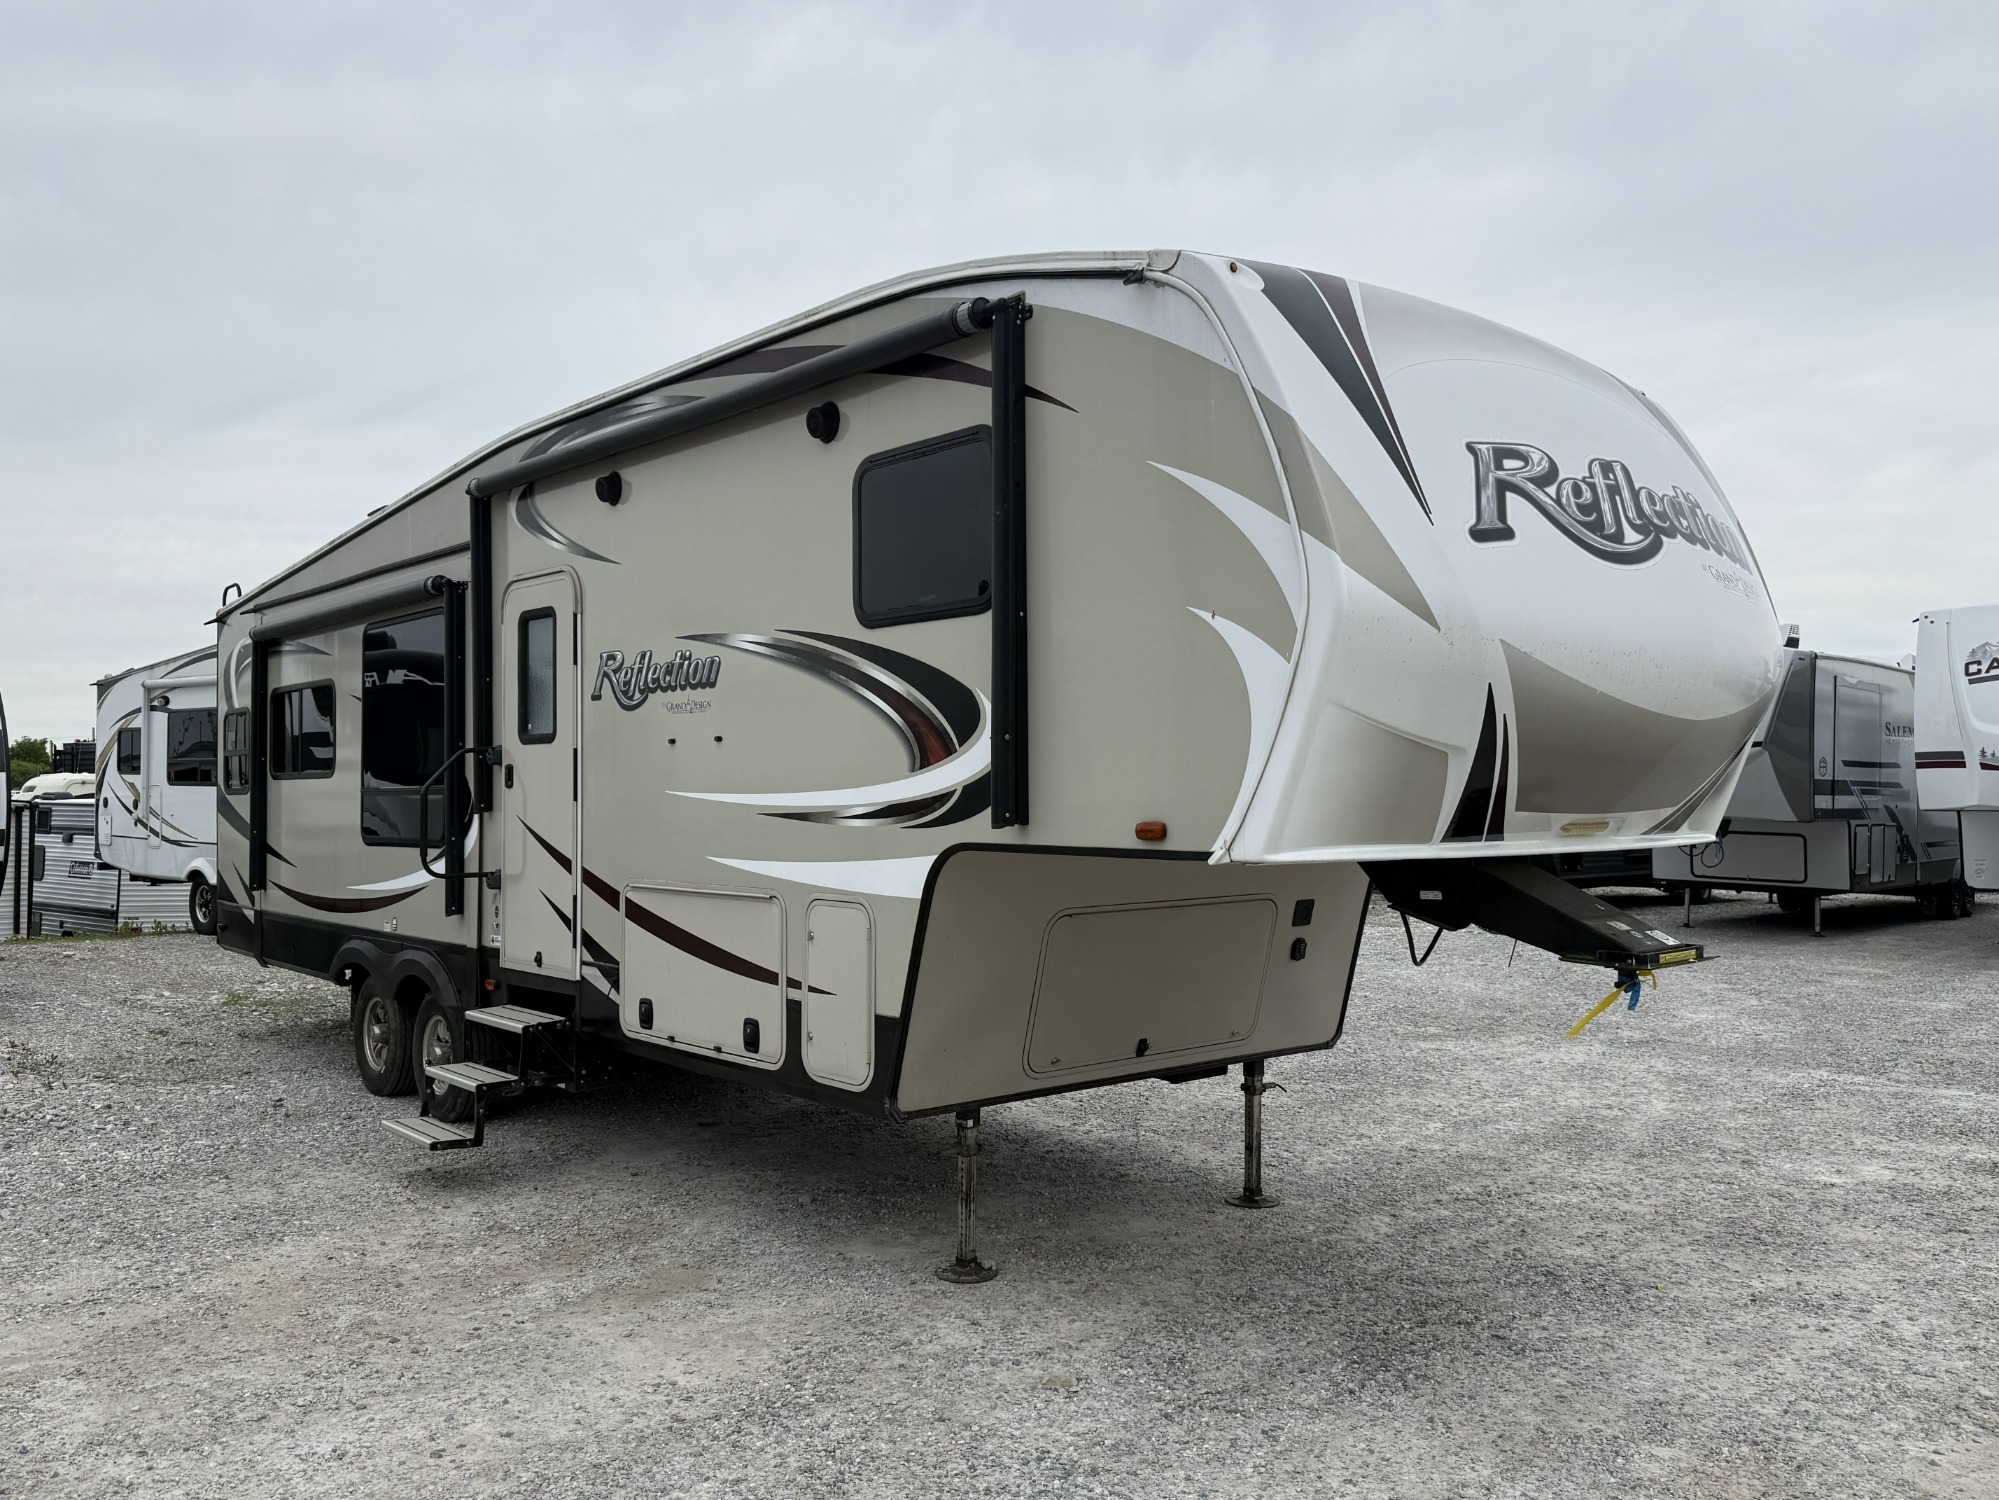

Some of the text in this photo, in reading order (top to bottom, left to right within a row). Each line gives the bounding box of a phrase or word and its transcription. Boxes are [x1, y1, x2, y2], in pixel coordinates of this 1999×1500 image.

[1465, 441, 1752, 574] Reflection
[591, 649, 721, 712] Reflection
[666, 701, 687, 711] GRAND
[690, 700, 711, 710] DESIGN
